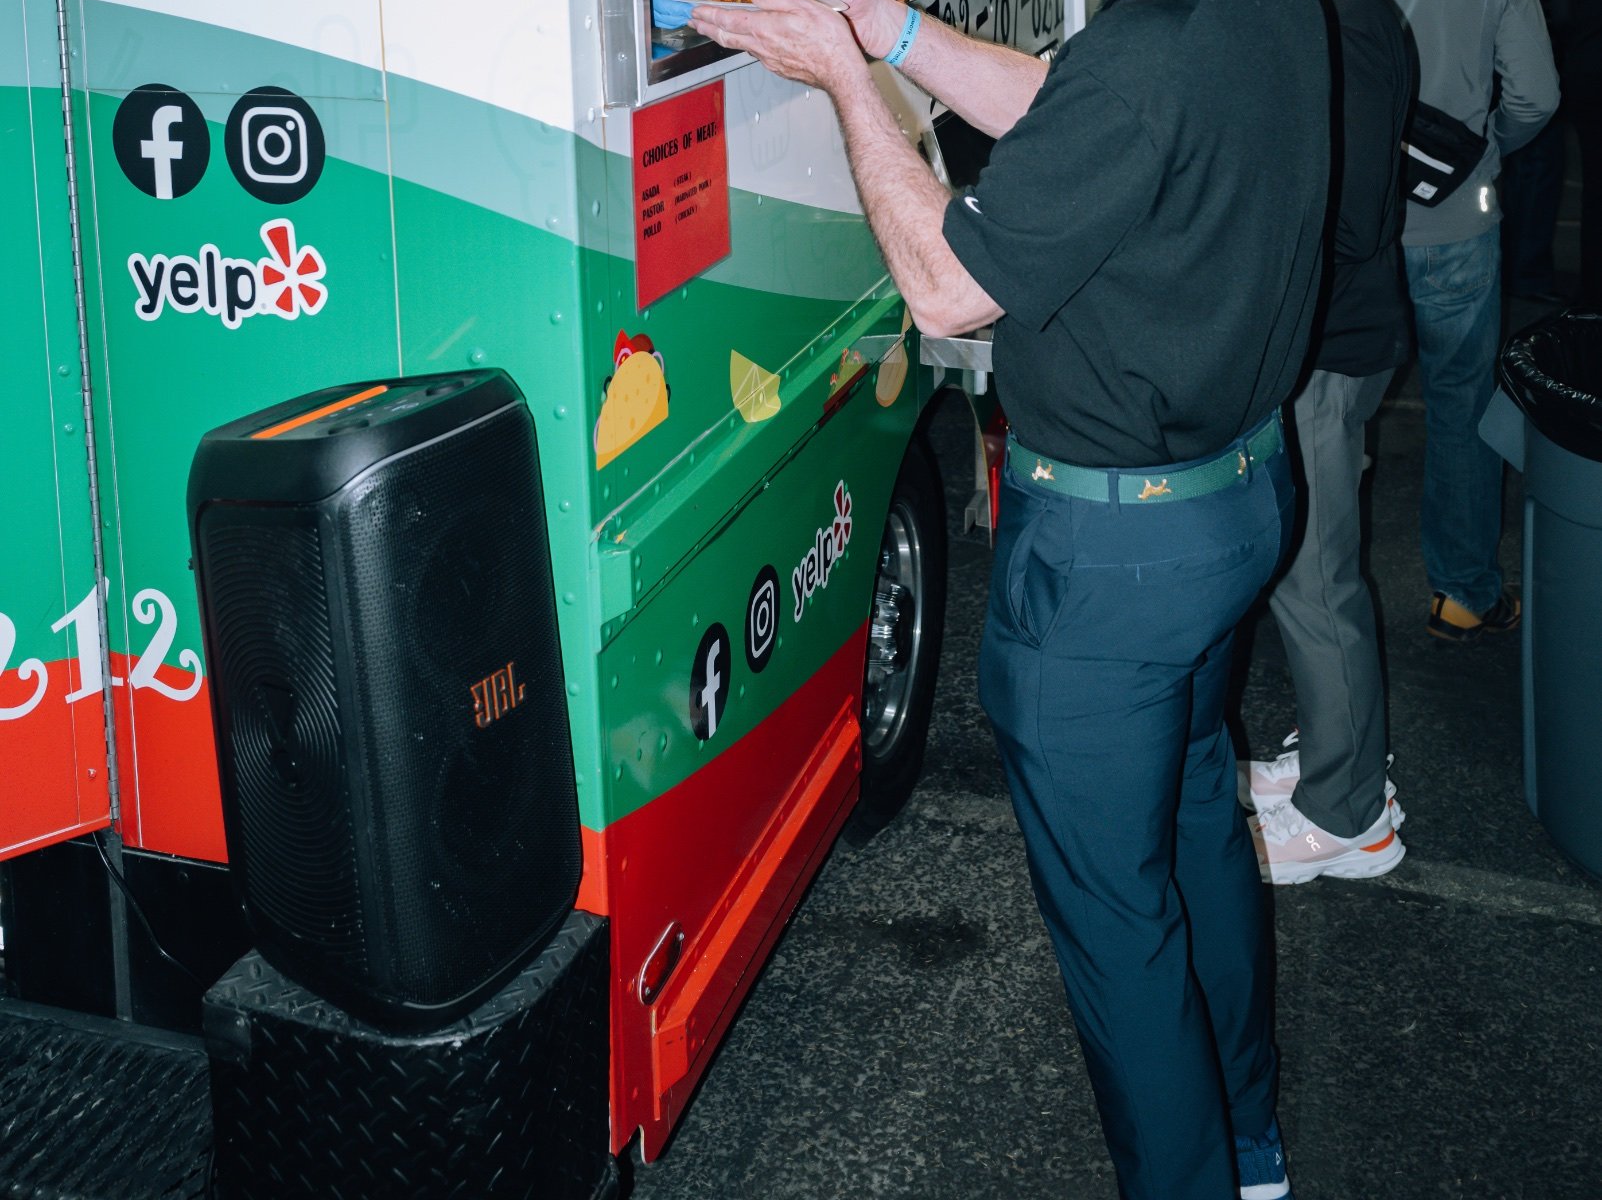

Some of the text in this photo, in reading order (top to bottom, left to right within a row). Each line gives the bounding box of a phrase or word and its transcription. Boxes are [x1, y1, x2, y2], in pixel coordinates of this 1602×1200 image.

[643, 122, 717, 168] CHOICES OF MEAT:
[642, 184, 660, 202] ASADA
[643, 201, 664, 221] PASTOR
[643, 221, 661, 240] POLLO
[131, 249, 258, 324] yelp
[793, 527, 834, 621] yelp
[470, 661, 526, 729] JBL
